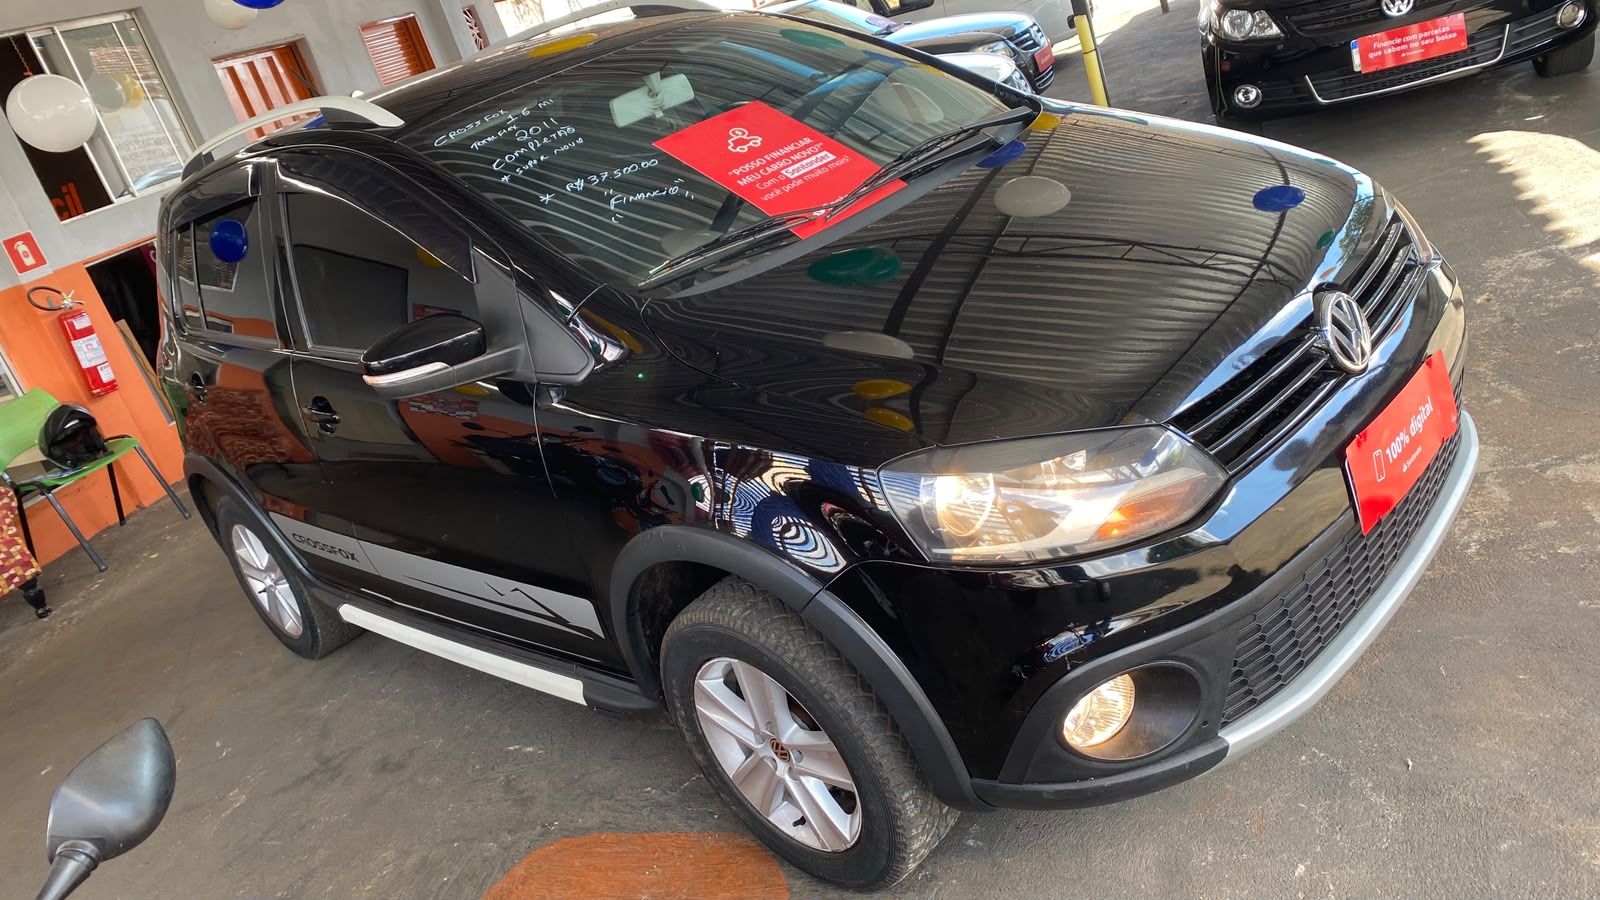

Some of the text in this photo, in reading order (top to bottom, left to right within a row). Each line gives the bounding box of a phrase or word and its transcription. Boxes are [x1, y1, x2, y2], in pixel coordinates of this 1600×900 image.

[1368, 50, 1382, 59] que
[1383, 44, 1408, 54] cabem
[1409, 41, 1419, 49] no
[1420, 38, 1434, 46] seu
[1436, 32, 1457, 42] bolso
[1373, 26, 1450, 49] Financie com parcelas
[515, 117, 558, 142] 2011
[764, 137, 814, 161] FINANCIAR
[737, 172, 761, 186] MEU
[760, 158, 792, 176] CARRO
[756, 153, 831, 190] Com o Santander
[761, 188, 783, 201] você
[782, 178, 804, 193] pode
[804, 166, 829, 182] muito
[1385, 396, 1434, 464] 100% digital
[291, 533, 360, 562] CROSSFOX
